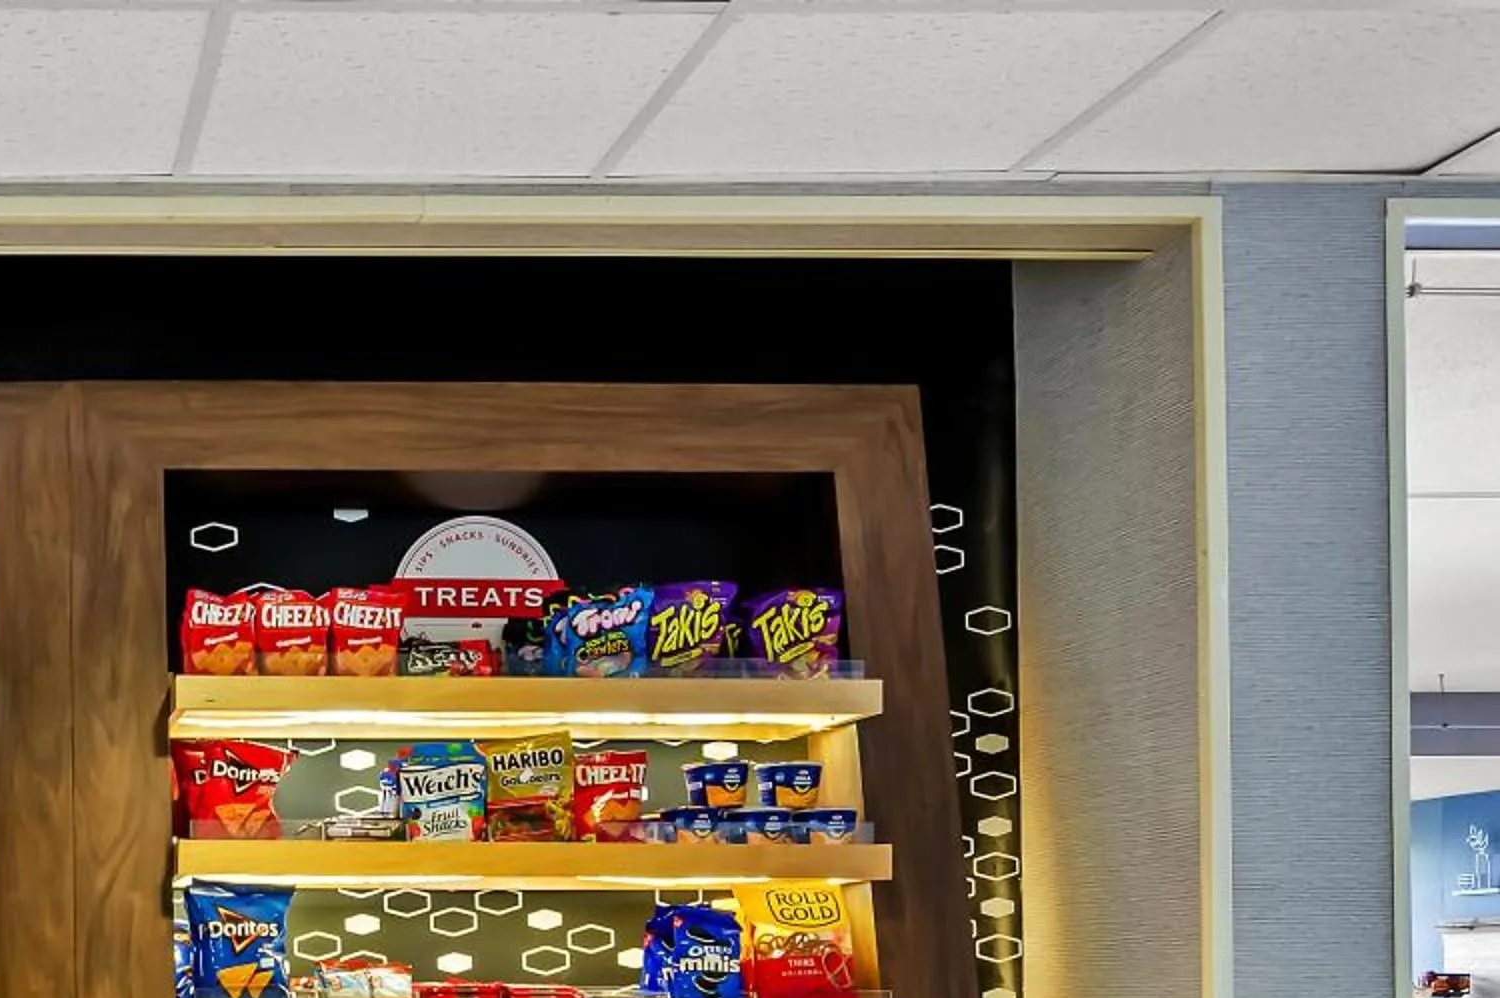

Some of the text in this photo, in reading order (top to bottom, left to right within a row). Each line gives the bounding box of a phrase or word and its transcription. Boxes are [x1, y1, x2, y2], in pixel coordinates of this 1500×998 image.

[440, 531, 484, 548] SNACKS
[496, 533, 541, 575] SUNDRIES
[414, 587, 544, 607] TREATS
[651, 597, 722, 661] Takis
[752, 598, 830, 663] Takis
[213, 760, 280, 783] Doritos
[492, 748, 564, 773] HARIBO
[775, 890, 830, 905] ROLD
[778, 906, 834, 921] GOLD
[208, 921, 279, 938] Doritos
